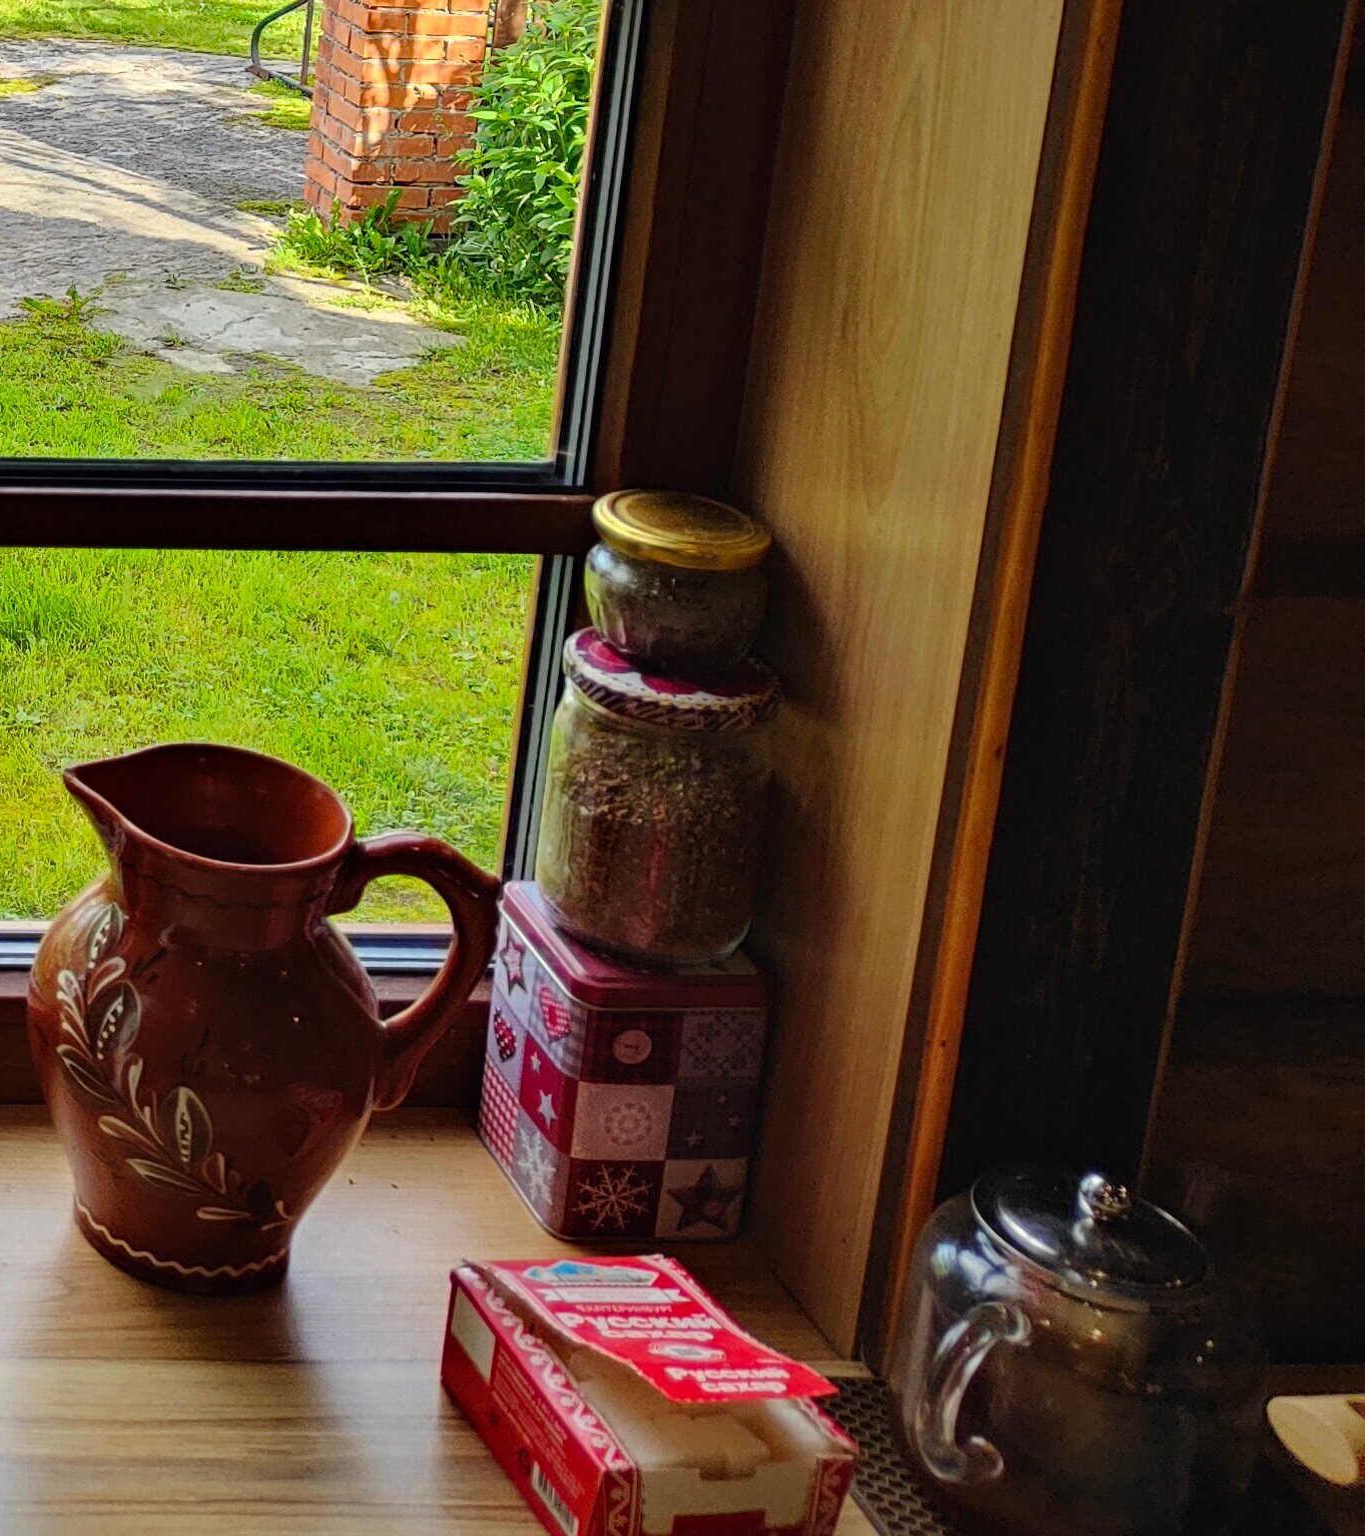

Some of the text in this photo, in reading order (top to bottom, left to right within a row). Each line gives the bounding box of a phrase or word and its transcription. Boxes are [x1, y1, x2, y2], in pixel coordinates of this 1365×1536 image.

[556, 1312, 723, 1331] Русский
[600, 1329, 714, 1342] сахар
[664, 1366, 790, 1381] Русский
[700, 1381, 787, 1394] сахар
